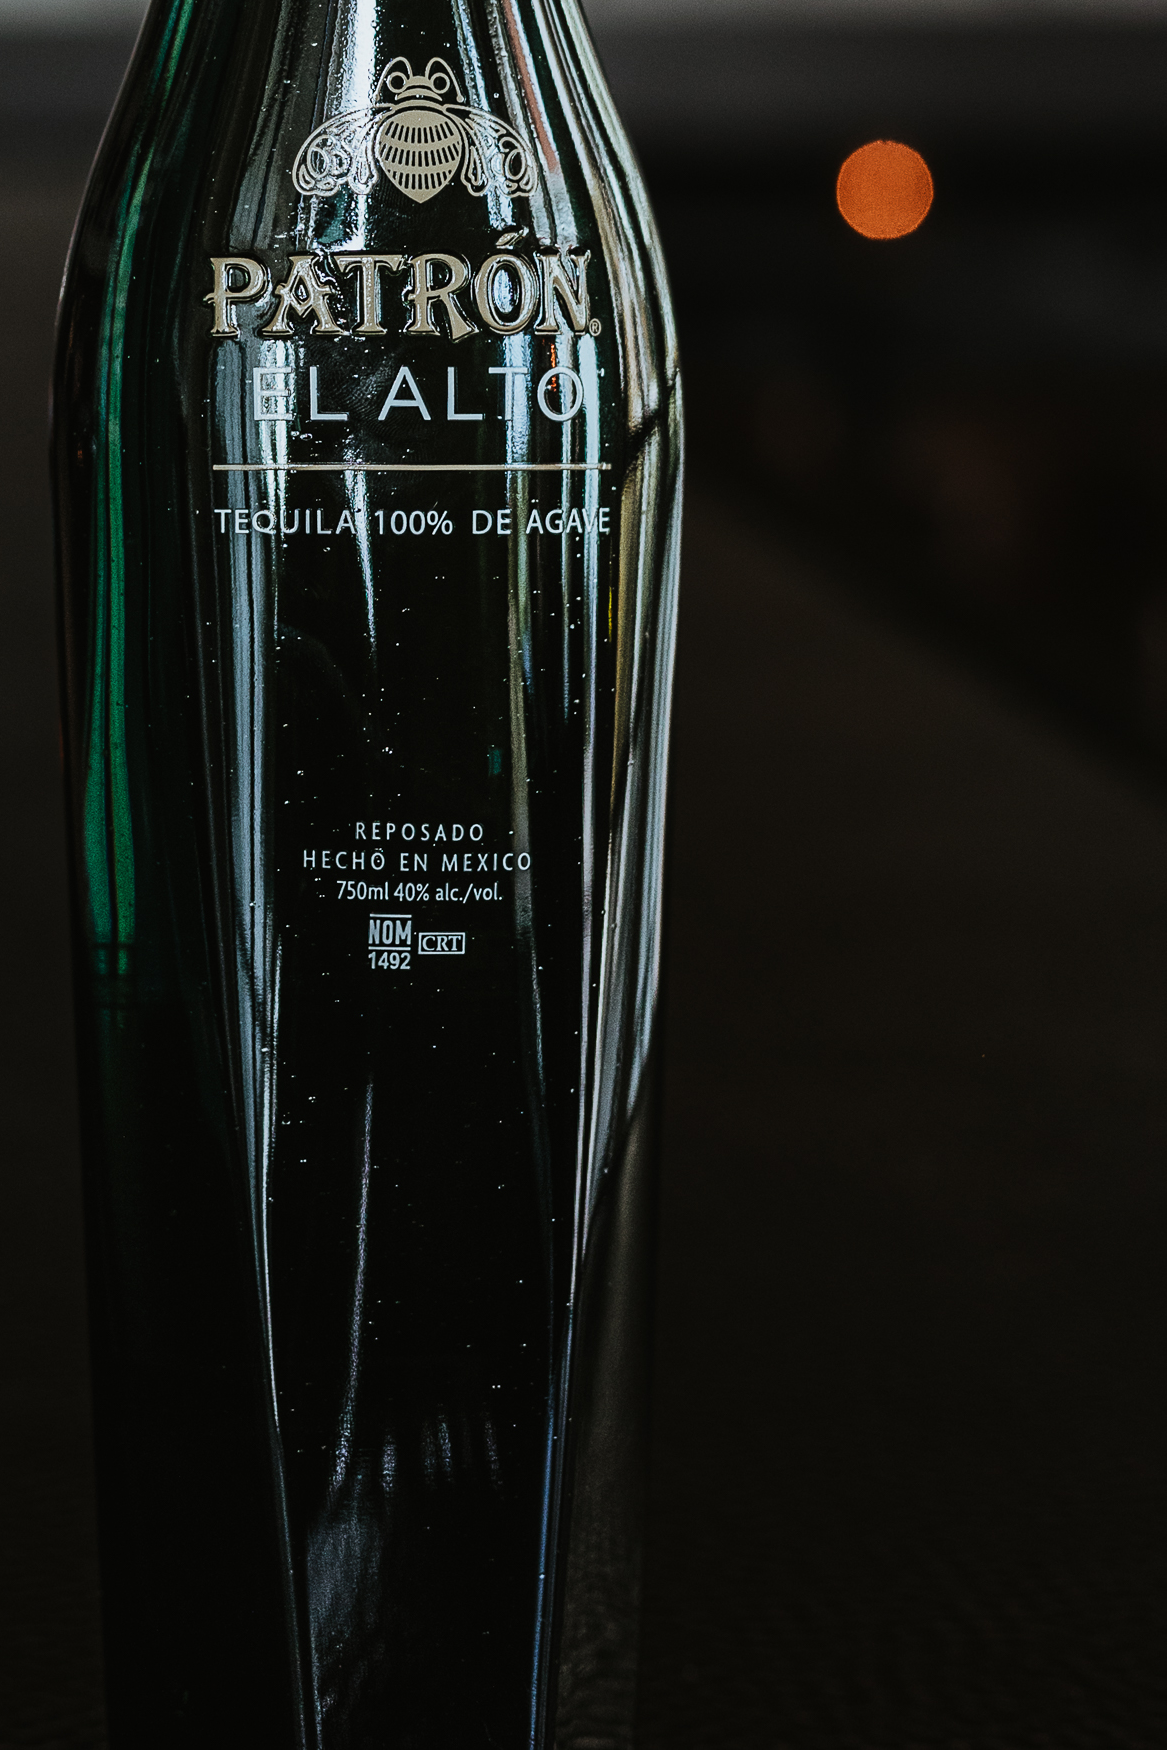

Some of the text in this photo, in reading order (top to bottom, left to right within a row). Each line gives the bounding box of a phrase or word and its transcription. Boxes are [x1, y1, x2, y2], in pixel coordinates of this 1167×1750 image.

[253, 365, 584, 423] EL ALTO
[214, 507, 611, 536] TEQUILA 100% DE AGAVE
[355, 822, 484, 842] REPOSADO
[303, 850, 531, 872] HECHO EN MEXICO
[336, 880, 503, 904] 750ml 40% alc./vol.
[368, 919, 412, 945] NOM
[421, 935, 462, 952] CRT
[367, 952, 411, 970] 1492
